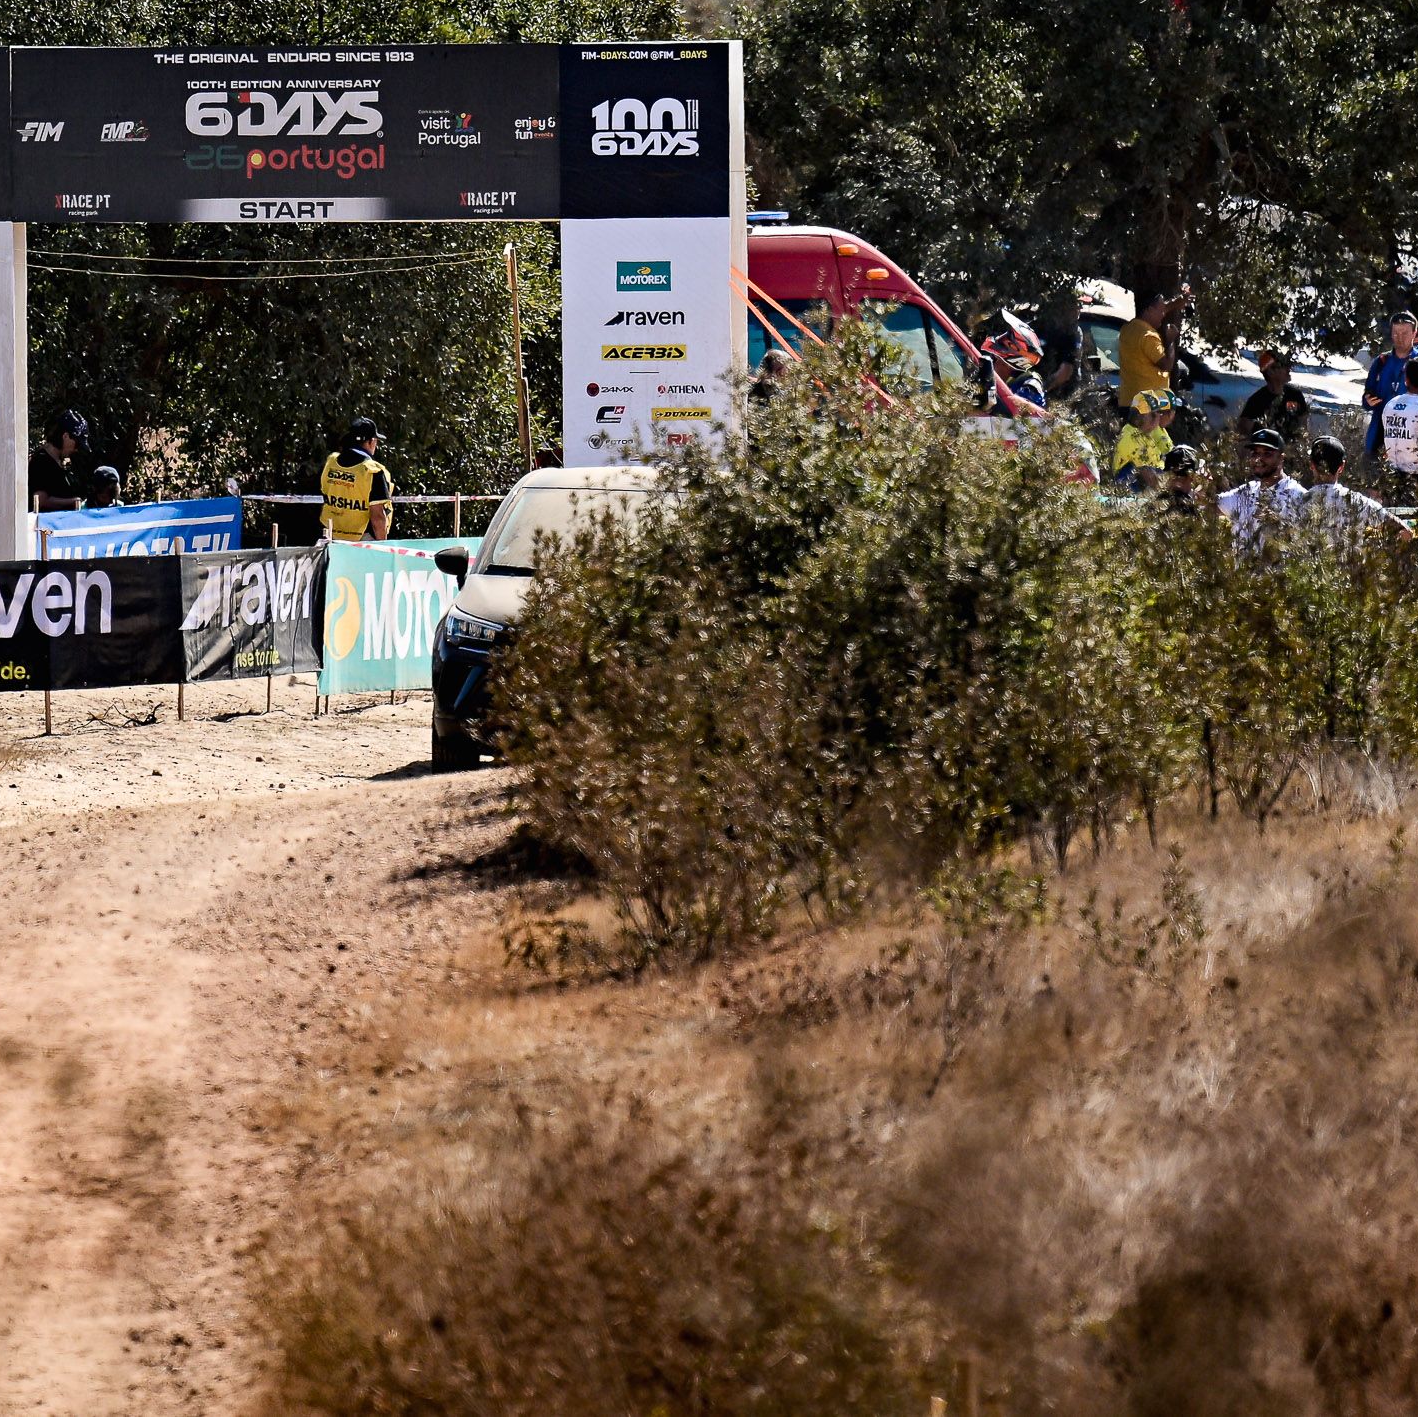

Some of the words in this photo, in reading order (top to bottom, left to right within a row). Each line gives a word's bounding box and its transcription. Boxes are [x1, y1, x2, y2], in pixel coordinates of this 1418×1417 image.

[154, 54, 184, 64] THE
[188, 53, 259, 63] ORIGINAL
[267, 53, 331, 63] ENDURO
[335, 52, 381, 62] SINCE
[385, 51, 415, 62] 1913
[581, 51, 648, 60] FIM-6DAYS.COM
[650, 50, 708, 61] @FIM_6DAYS
[186, 81, 226, 89] 100TH
[230, 80, 282, 89] EDITION
[286, 79, 382, 88] ANNIVERSARY
[185, 91, 383, 137] 6DAYS
[101, 121, 135, 139] FMP
[420, 117, 451, 130] visit
[514, 117, 546, 131] enjoy
[18, 122, 65, 142] FIM
[514, 130, 533, 140] fun
[418, 132, 481, 148] Portugal
[239, 201, 335, 219] START
[620, 274, 667, 286] MOTOREX
[625, 310, 685, 326] raven
[668, 385, 706, 394] ATHENA
[324, 494, 369, 511] ARSHAL
[221, 556, 314, 628] raven
